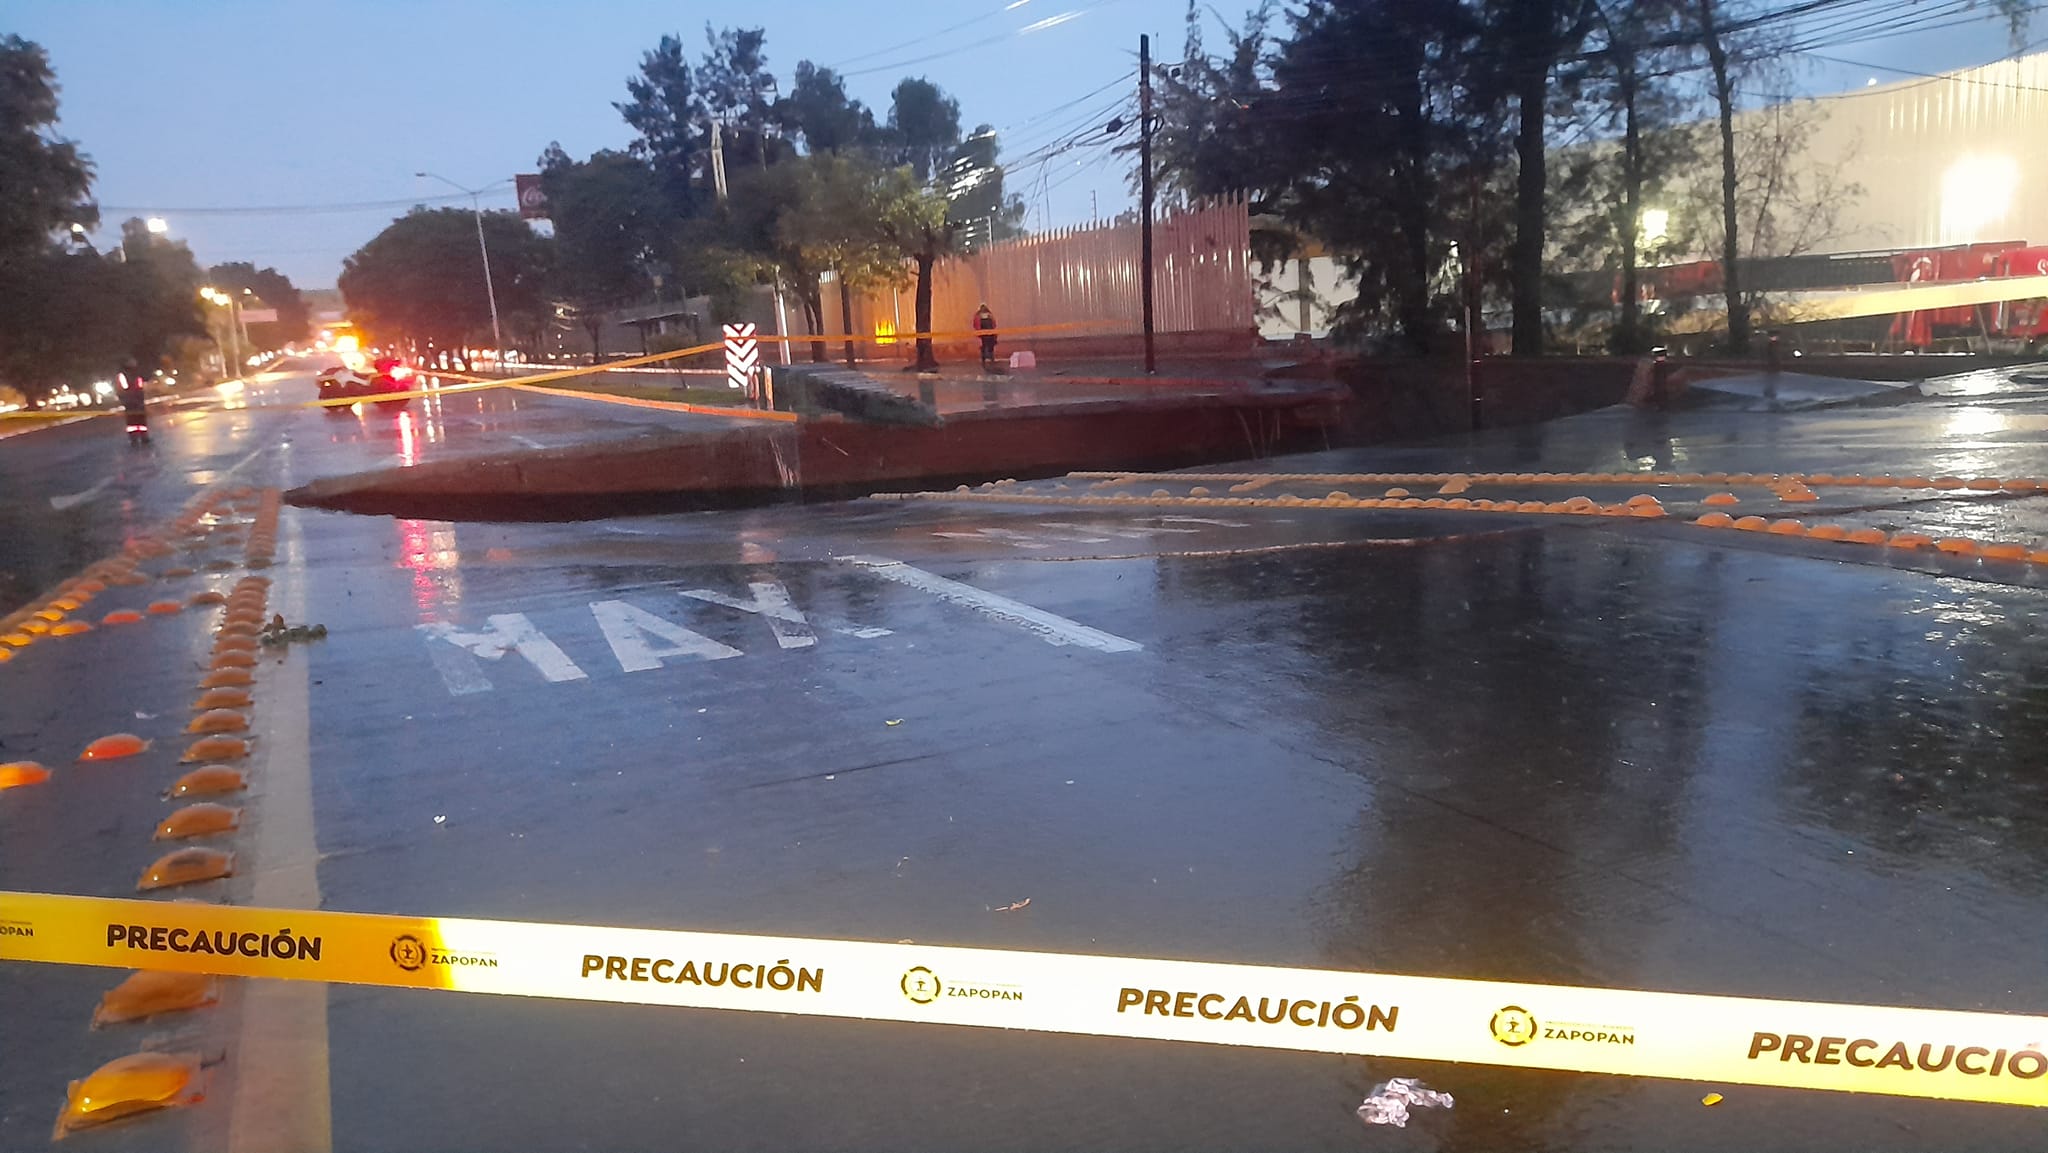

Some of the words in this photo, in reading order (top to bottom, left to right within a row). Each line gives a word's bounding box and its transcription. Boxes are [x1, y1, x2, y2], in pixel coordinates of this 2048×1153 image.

[107, 924, 321, 960] PRECAUCIÓN
[430, 954, 498, 967] ZAPOPAN
[582, 955, 824, 992] PRECAUCIÓN
[948, 987, 1023, 1001] ZAPOPAN
[1117, 987, 1398, 1032] PRECAUCIÓN
[1544, 1028, 1634, 1045] ZAPOPAN
